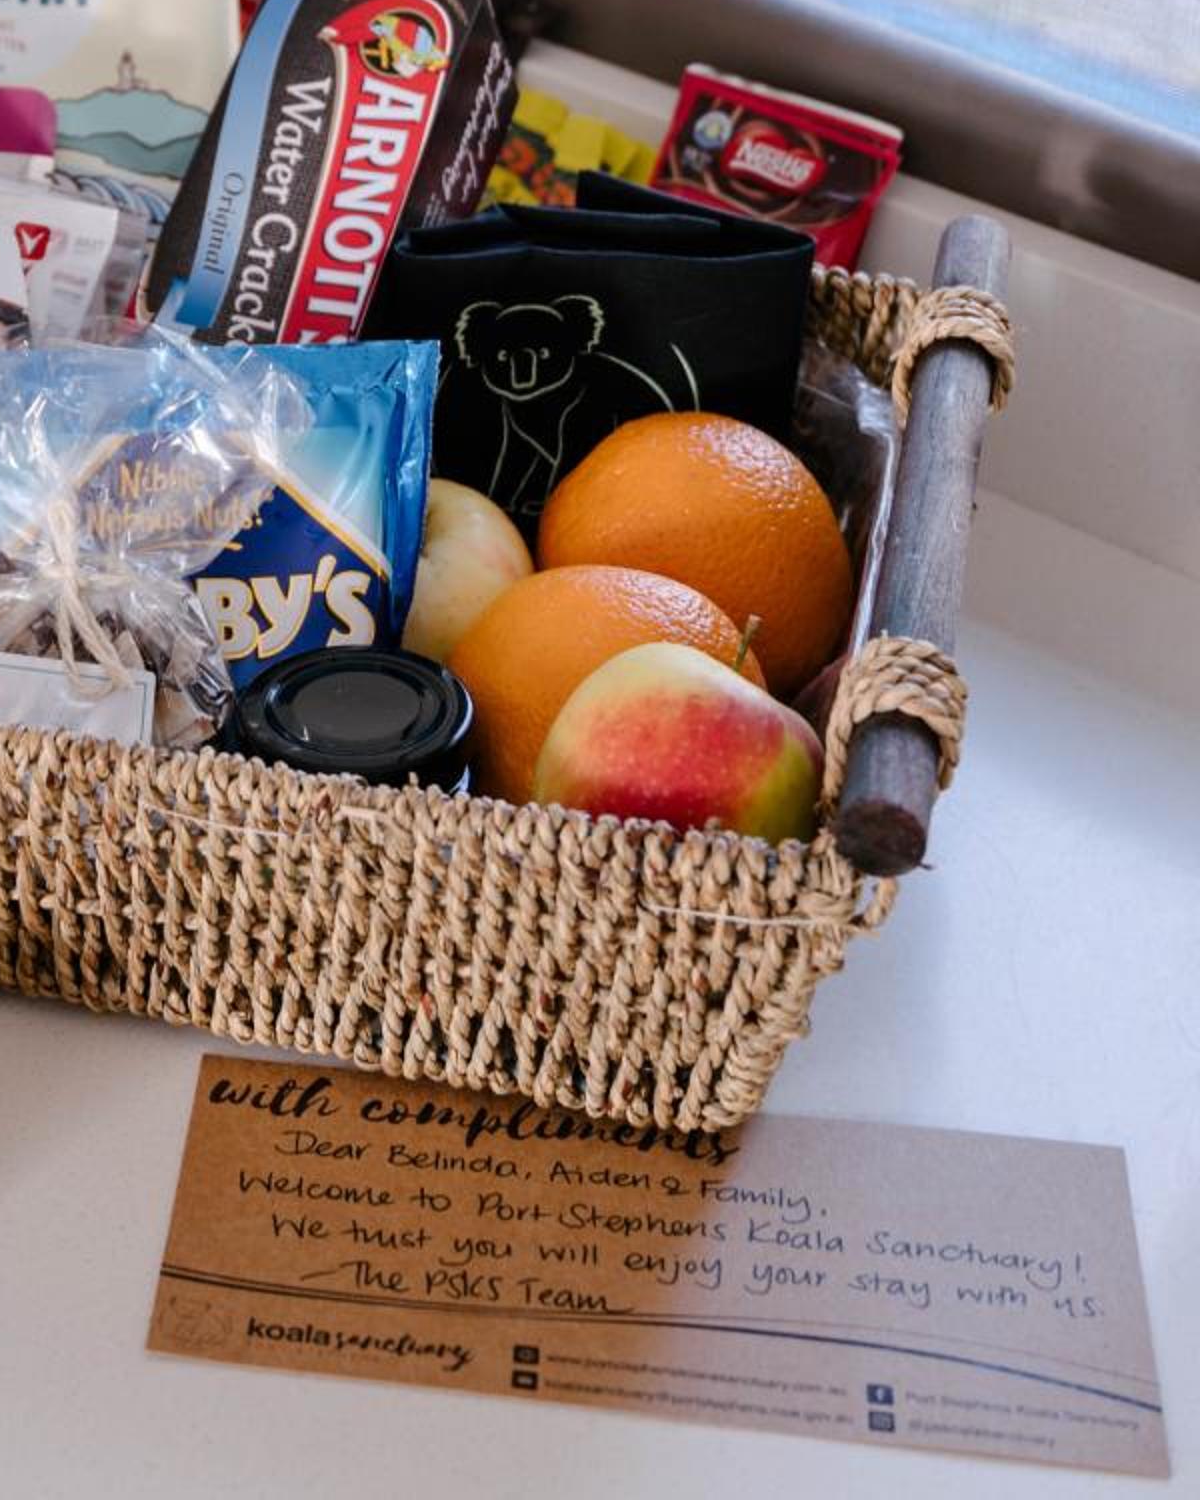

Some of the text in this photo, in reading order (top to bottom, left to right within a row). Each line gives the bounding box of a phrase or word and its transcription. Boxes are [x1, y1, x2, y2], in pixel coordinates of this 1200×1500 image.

[262, 76, 333, 207] Water
[204, 170, 246, 277] Original
[208, 1075, 740, 1167] with compliments
[274, 1129, 368, 1163] Dear
[387, 1144, 533, 1181] Belinda,
[548, 1160, 651, 1192] Aiden
[238, 1170, 1089, 1291] Welcome to Port Stephens Koala Sanctuary!
[271, 1212, 329, 1240] We
[346, 1219, 433, 1249] trust
[438, 1237, 514, 1268] you
[539, 1242, 600, 1267] will
[623, 1251, 725, 1291] enjoy
[743, 1261, 828, 1295] your
[852, 1271, 933, 1311] stay
[955, 1283, 1029, 1308] with
[519, 1278, 634, 1315] Team
